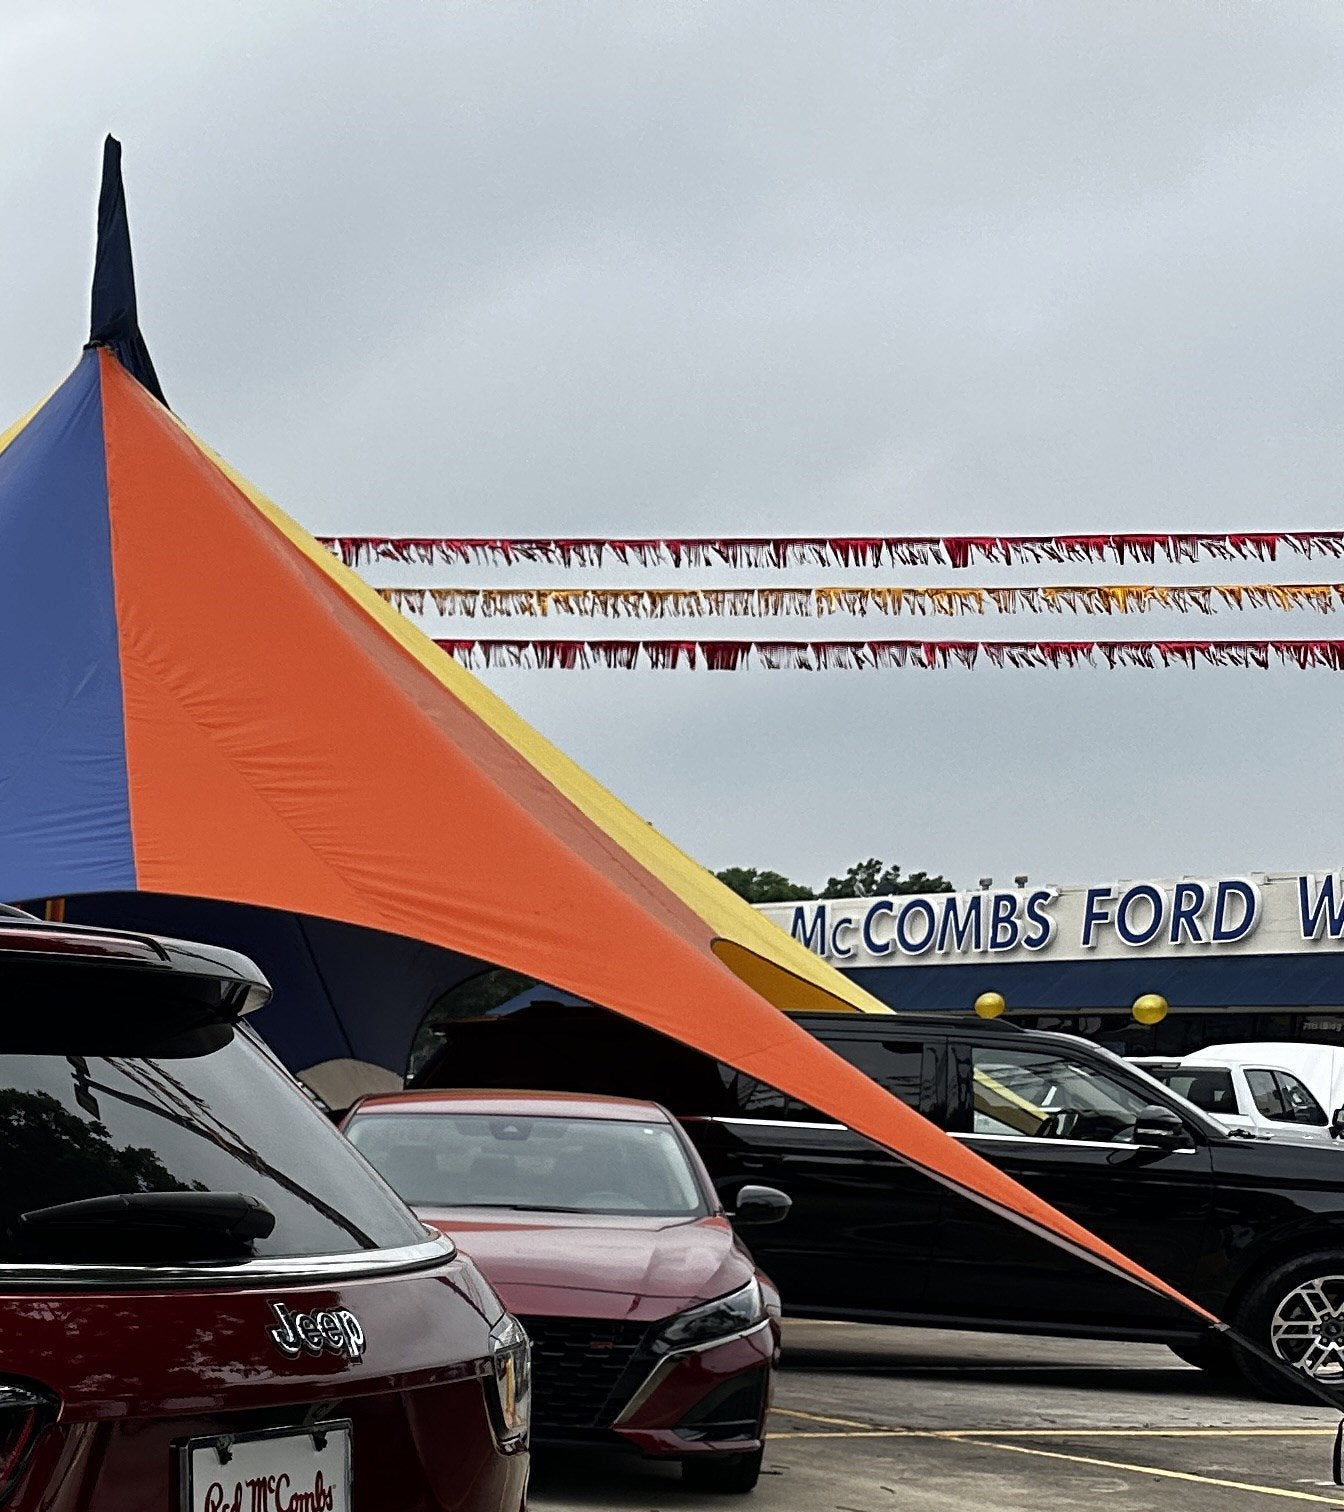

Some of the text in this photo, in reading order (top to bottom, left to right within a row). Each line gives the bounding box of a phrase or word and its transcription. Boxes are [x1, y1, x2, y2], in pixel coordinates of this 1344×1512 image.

[791, 891, 1054, 957] McCOMBS
[1080, 878, 1259, 948] FORD
[268, 1301, 365, 1361] Jeep
